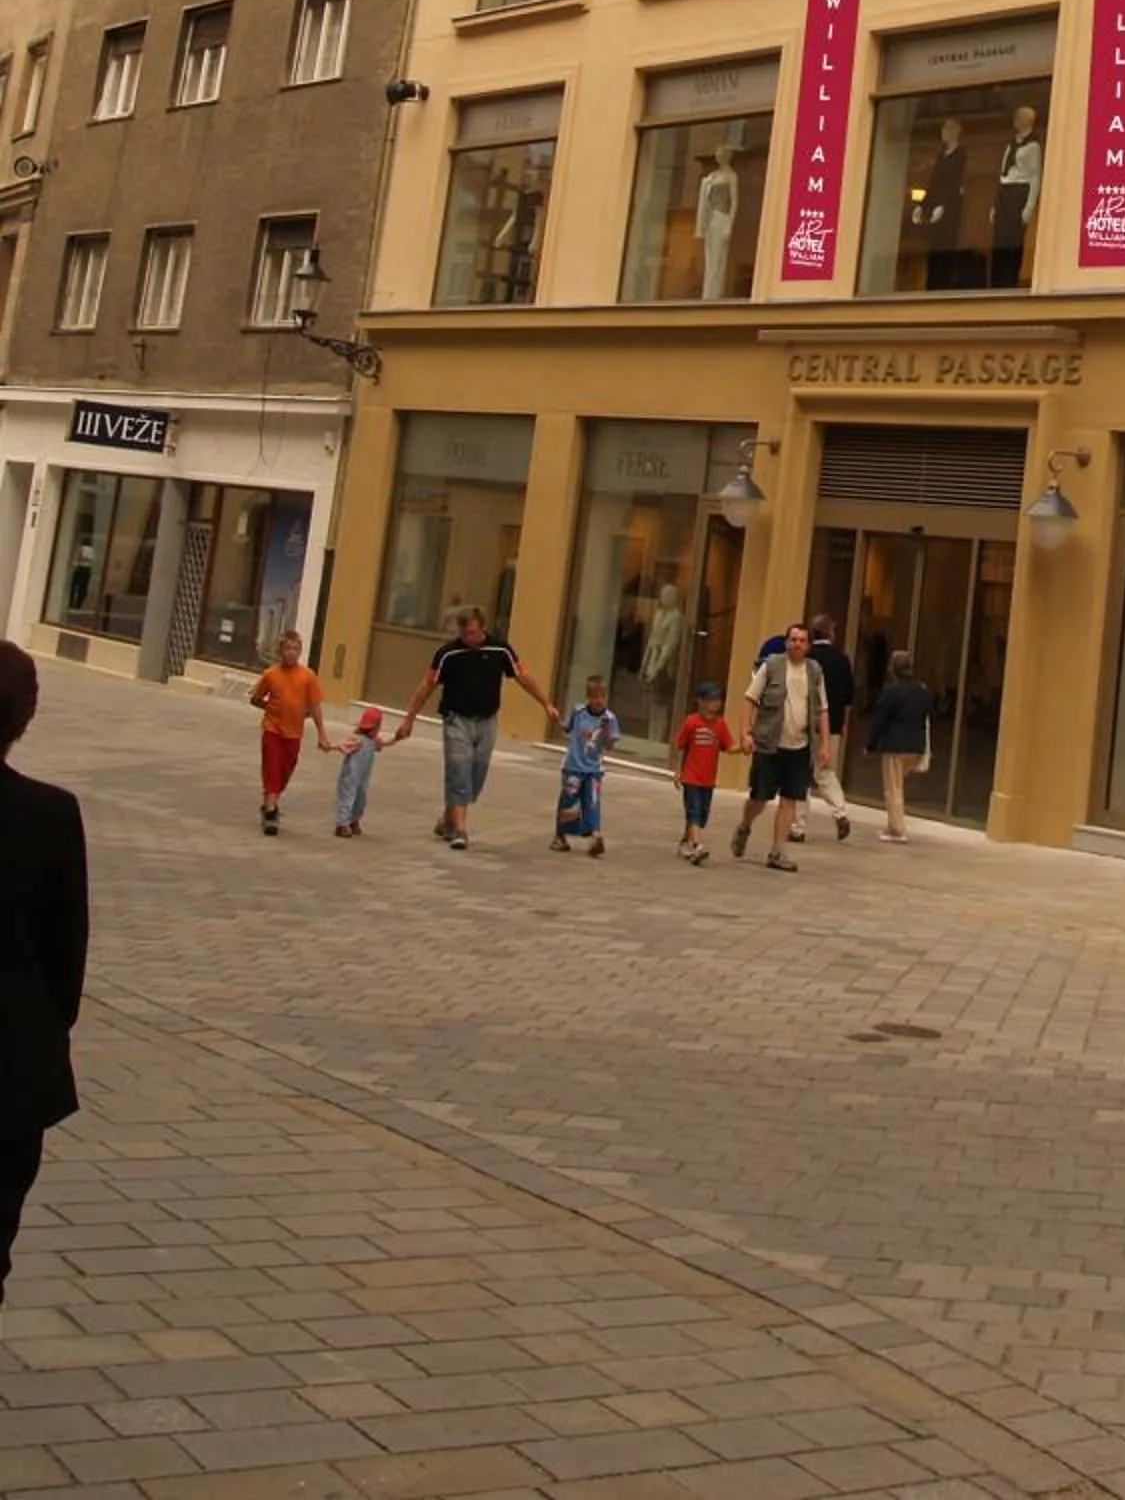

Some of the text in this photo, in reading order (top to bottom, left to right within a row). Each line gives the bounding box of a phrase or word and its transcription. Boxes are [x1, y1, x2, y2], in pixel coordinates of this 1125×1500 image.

[787, 353, 1083, 386] CENTRAL PASSAGE
[103, 412, 165, 445] VEŽE
